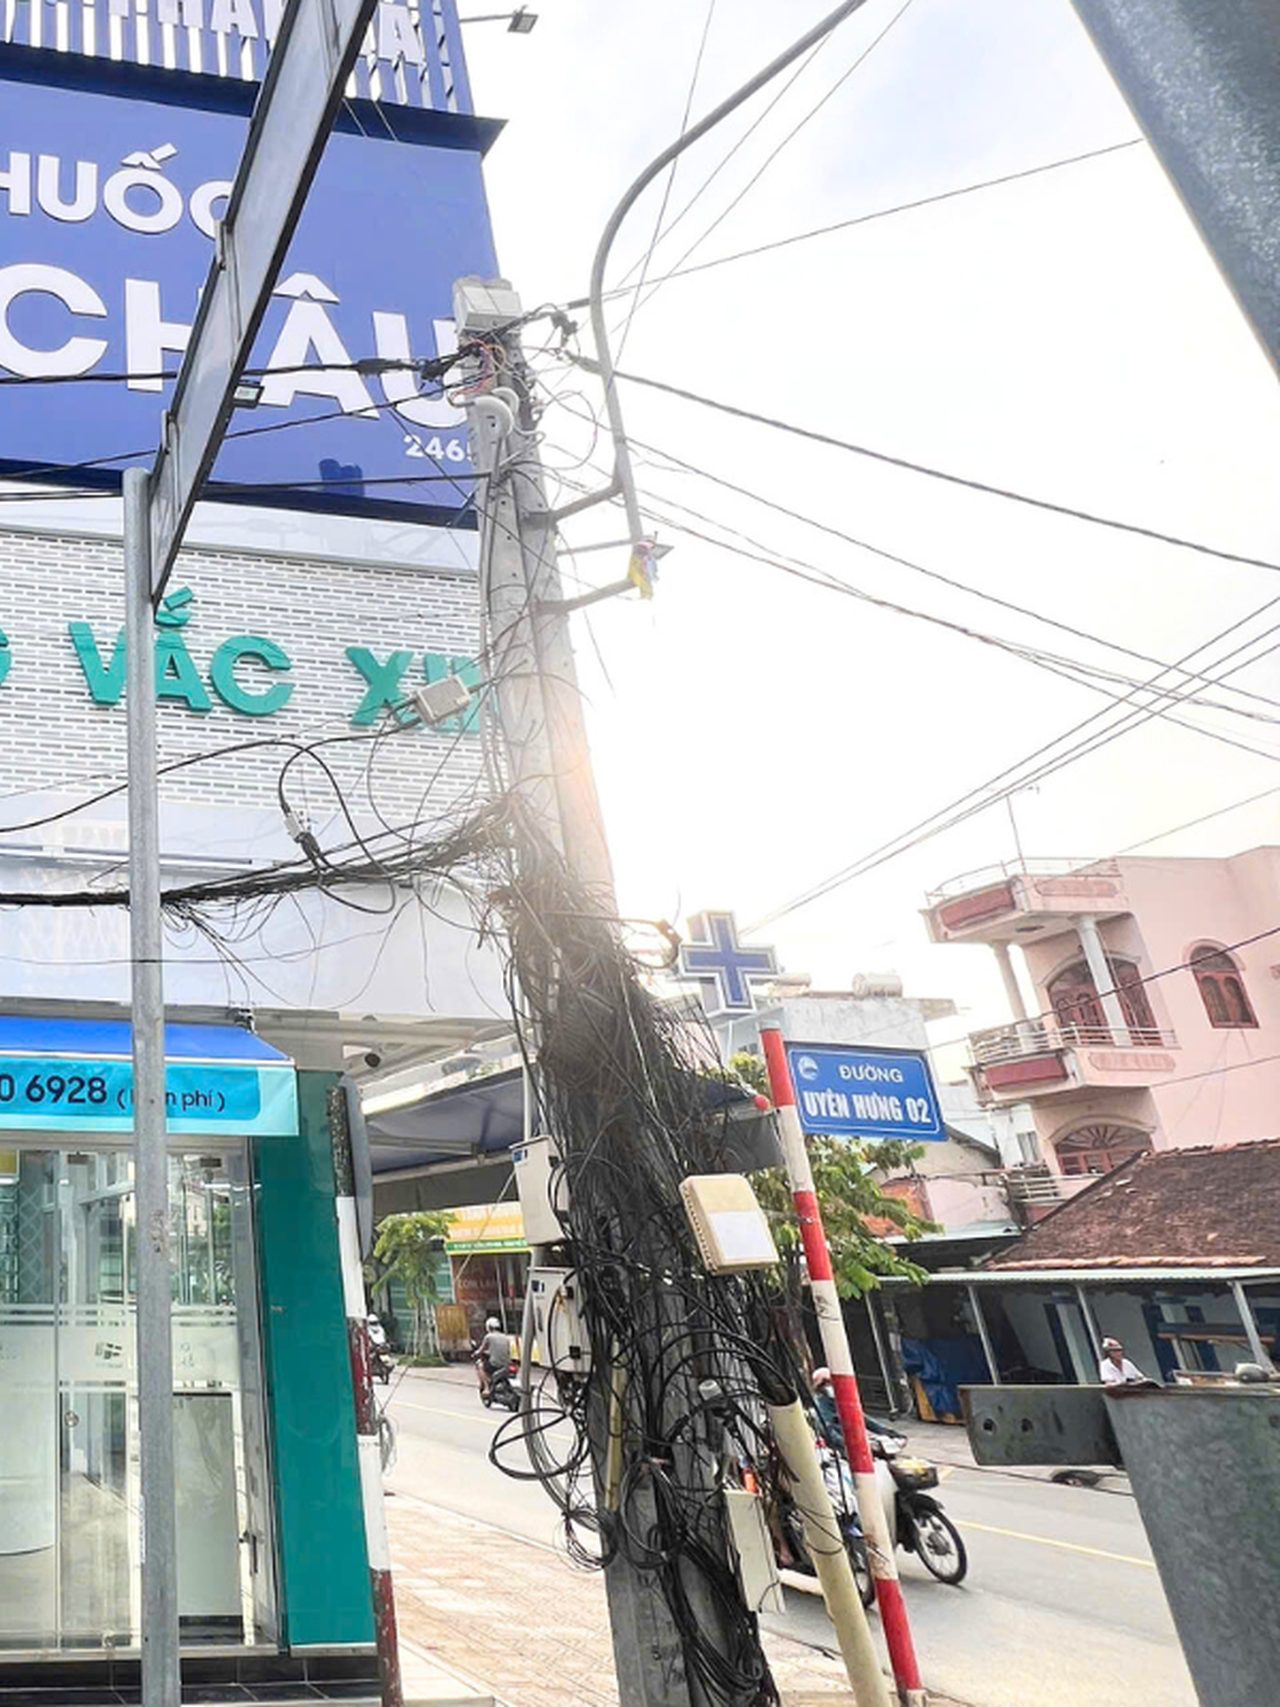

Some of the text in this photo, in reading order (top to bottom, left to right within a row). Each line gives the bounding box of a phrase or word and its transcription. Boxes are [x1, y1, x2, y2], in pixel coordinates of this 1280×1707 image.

[404, 434, 472, 462] 246
[68, 586, 296, 717] VẮC
[25, 1074, 108, 1104] 6928
[905, 1097, 932, 1123] 02
